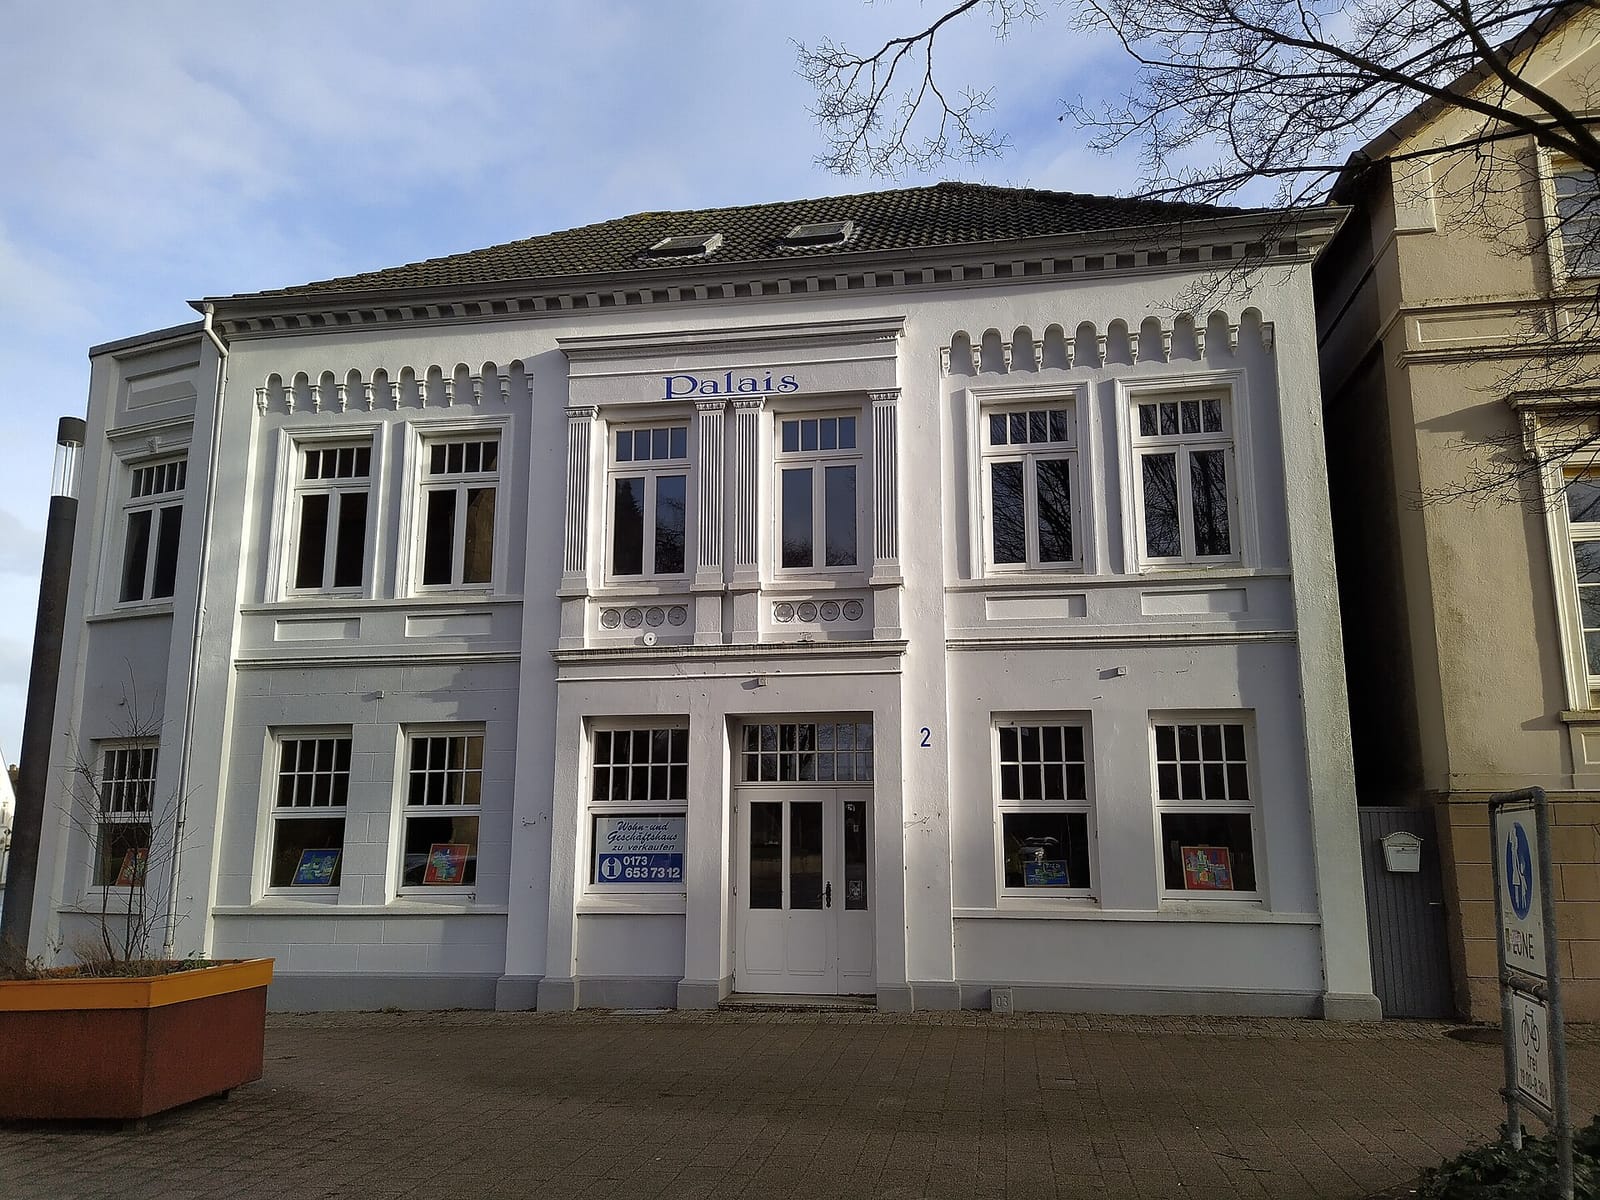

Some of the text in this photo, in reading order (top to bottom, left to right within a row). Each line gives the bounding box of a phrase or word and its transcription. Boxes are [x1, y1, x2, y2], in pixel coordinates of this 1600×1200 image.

[662, 370, 799, 400] Palais
[920, 727, 931, 747] 2
[607, 830, 678, 844] Geschäftshaus
